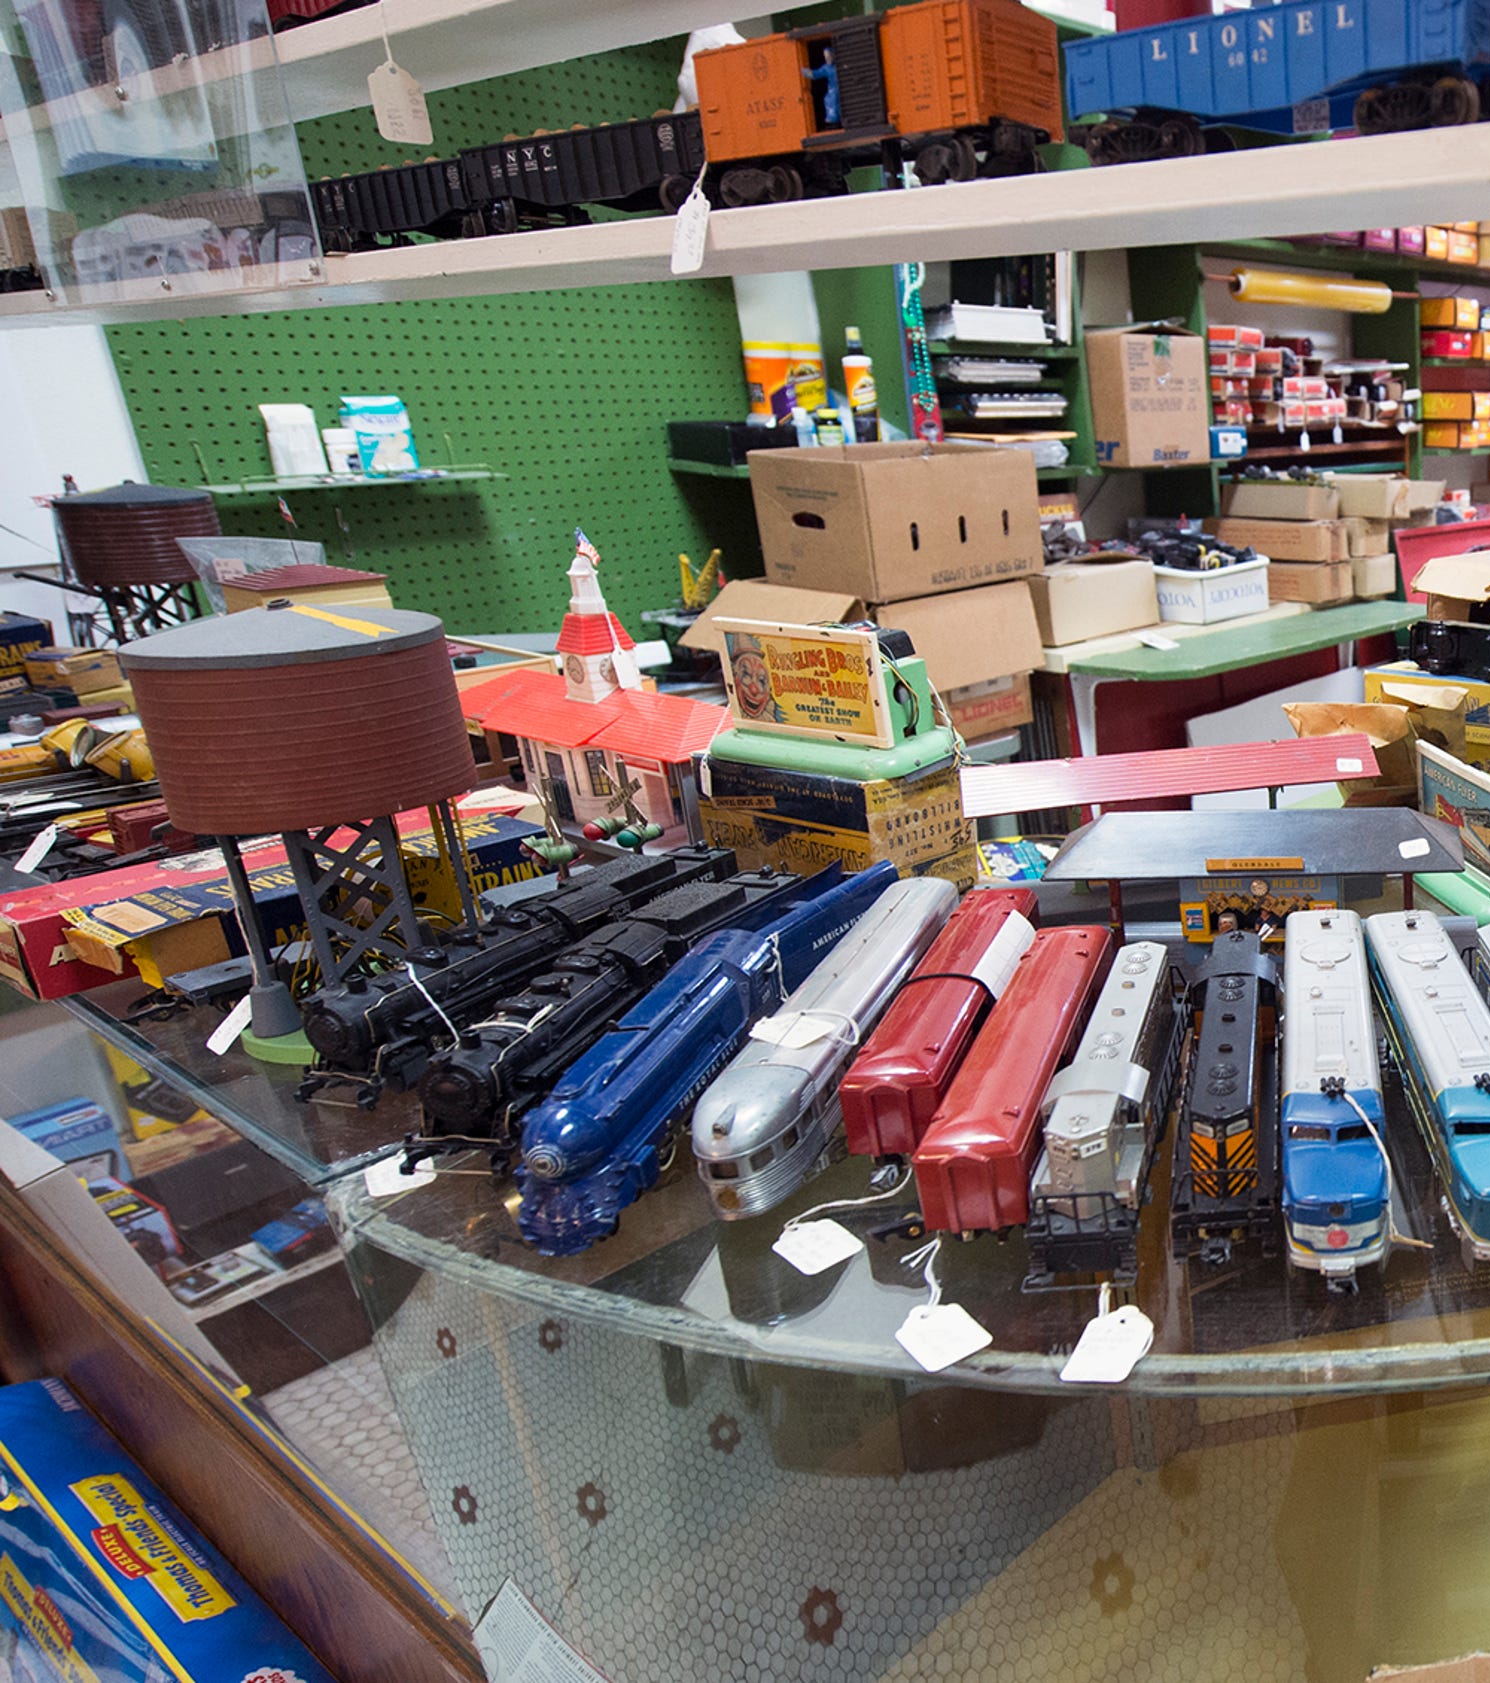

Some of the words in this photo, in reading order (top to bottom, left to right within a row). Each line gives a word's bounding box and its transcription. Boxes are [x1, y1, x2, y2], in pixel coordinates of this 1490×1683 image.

[1151, 4, 1354, 61] LIONEL
[1153, 448, 1191, 462] Baxter
[766, 644, 826, 671] RINGLING
[771, 672, 822, 697] BARNUM
[826, 680, 869, 704] BAILEY
[813, 670, 831, 678] AND
[795, 704, 834, 715] GREATEST
[836, 708, 860, 718] SHOW
[809, 714, 821, 722] ON
[824, 716, 852, 726] EARTH
[886, 800, 960, 831] BILLBOARD
[887, 817, 962, 849] WHISTLING
[1202, 879, 1243, 889] GILBERT
[1272, 878, 1299, 888] NEWS
[812, 923, 850, 951] AMERICAN
[694, 1060, 721, 1091] ROYAL
[91, 1482, 137, 1520] Special
[102, 1533, 139, 1573] DELUXE
[164, 1562, 214, 1608] Thomas
